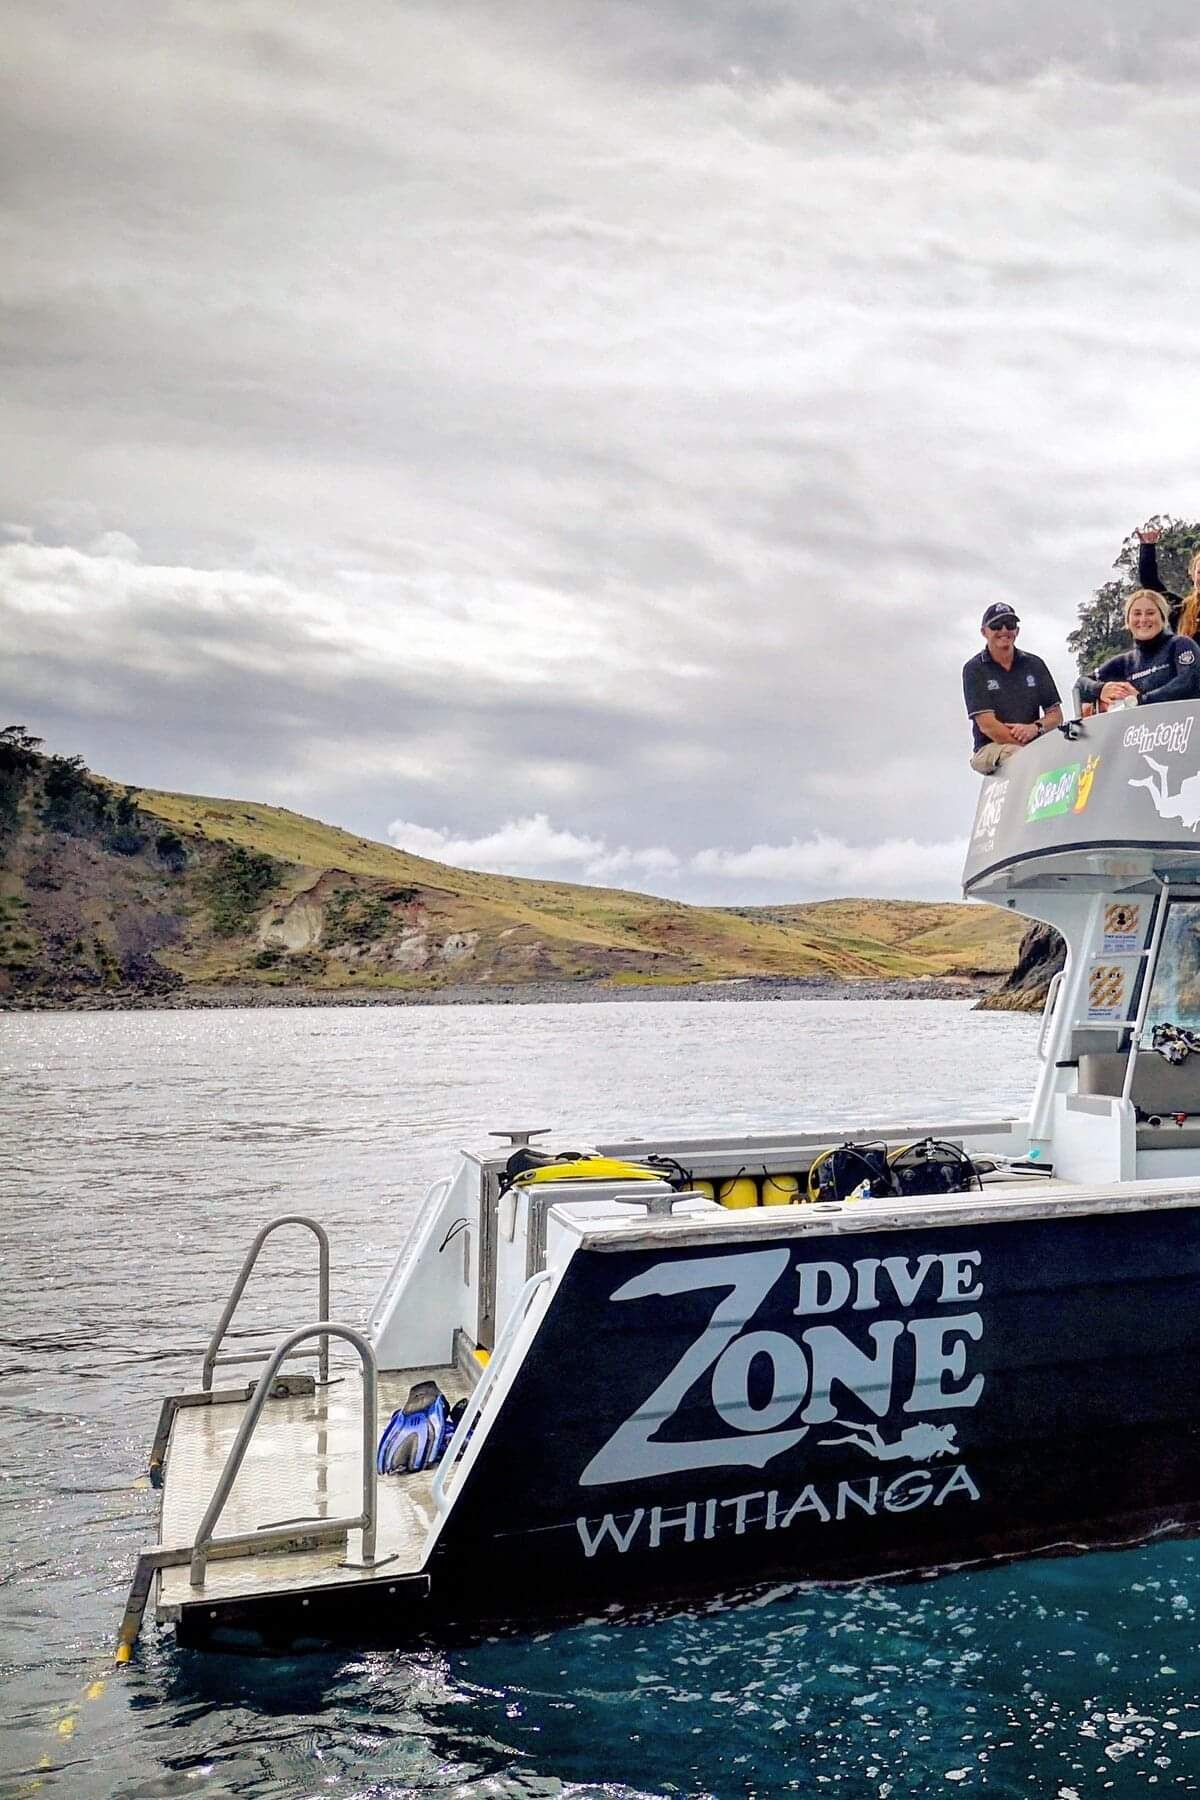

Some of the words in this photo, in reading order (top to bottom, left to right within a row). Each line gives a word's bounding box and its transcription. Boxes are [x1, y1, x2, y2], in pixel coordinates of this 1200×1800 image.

[793, 1250, 984, 1315] DIVE
[579, 1248, 985, 1486] ZONE
[576, 1464, 981, 1558] WHITIANGA
